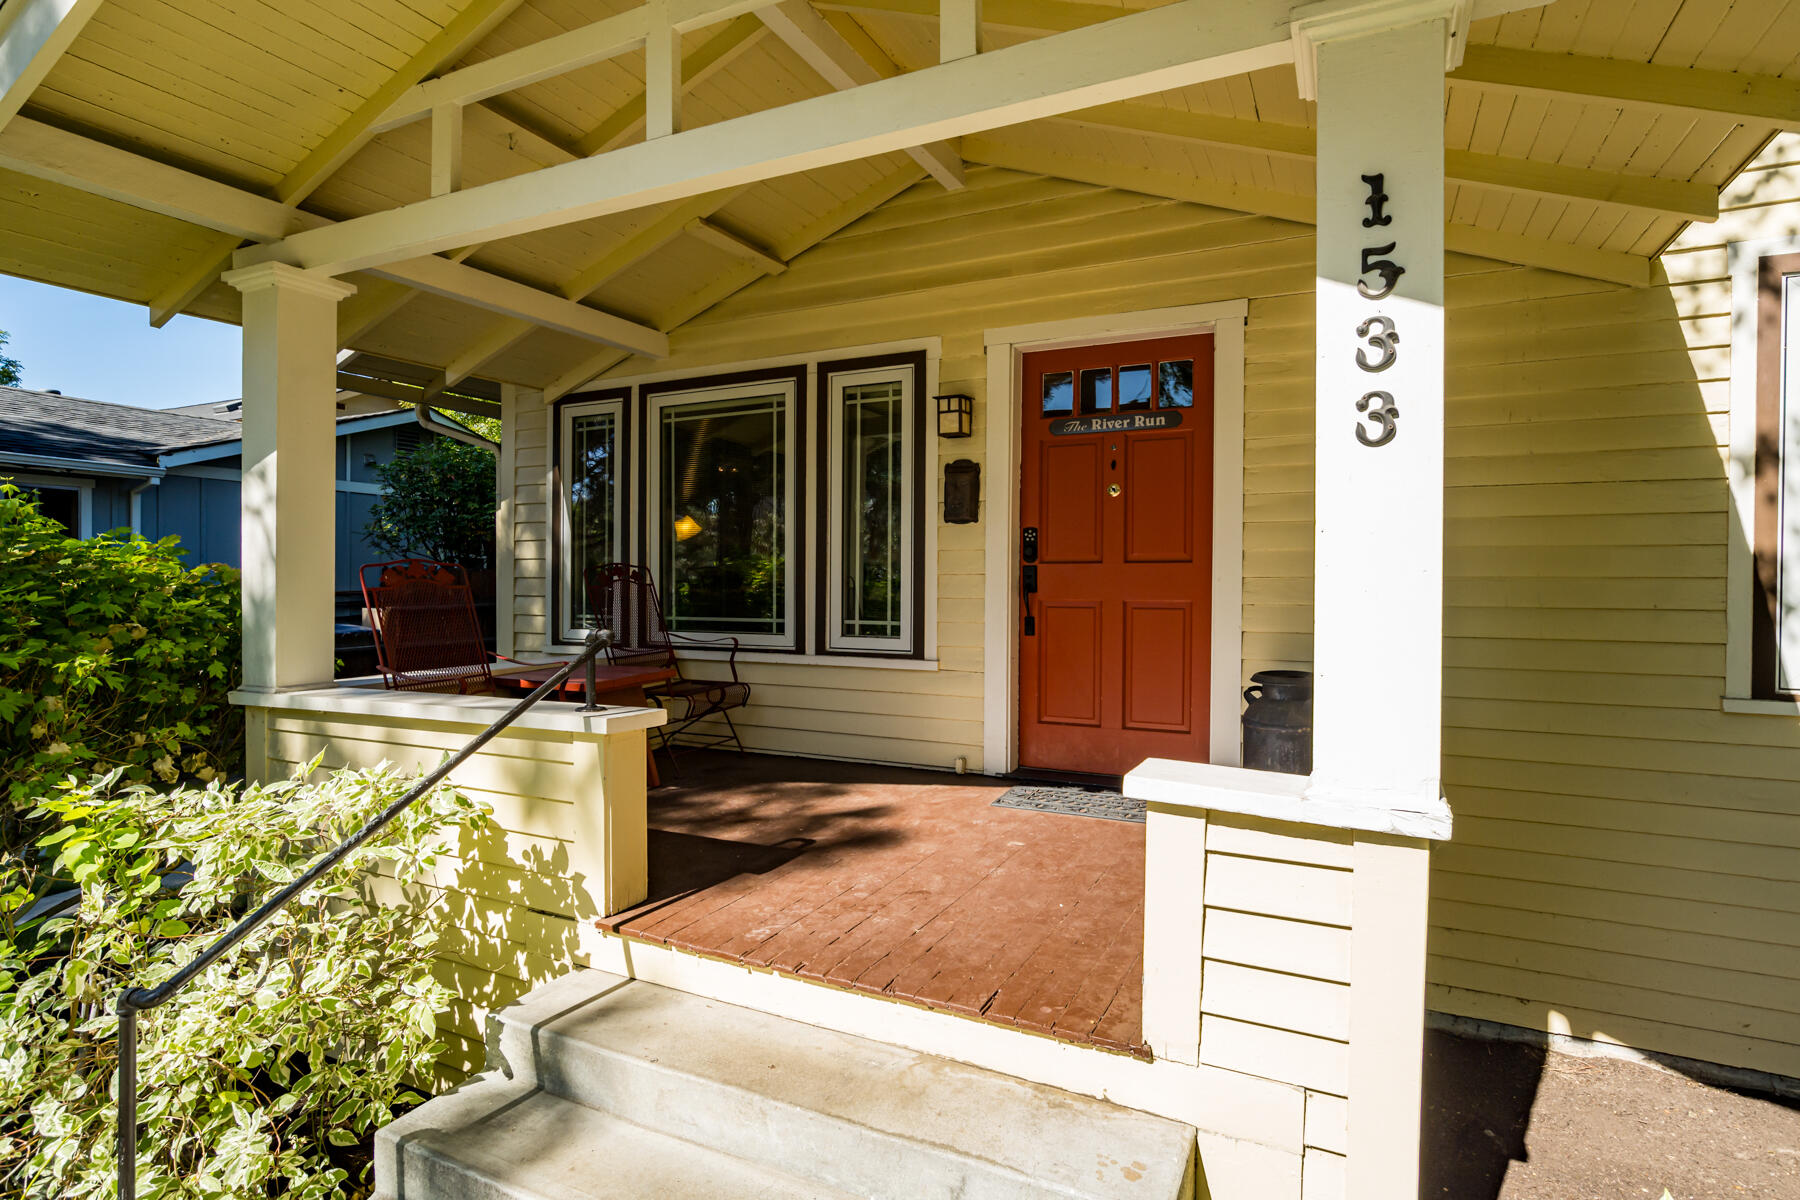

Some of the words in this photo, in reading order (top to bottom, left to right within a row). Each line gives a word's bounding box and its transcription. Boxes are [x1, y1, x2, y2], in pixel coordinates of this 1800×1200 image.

[1355, 172, 1406, 448] 1533
[1063, 420, 1088, 433] The
[1091, 417, 1130, 431] River
[1134, 415, 1166, 427] Run
